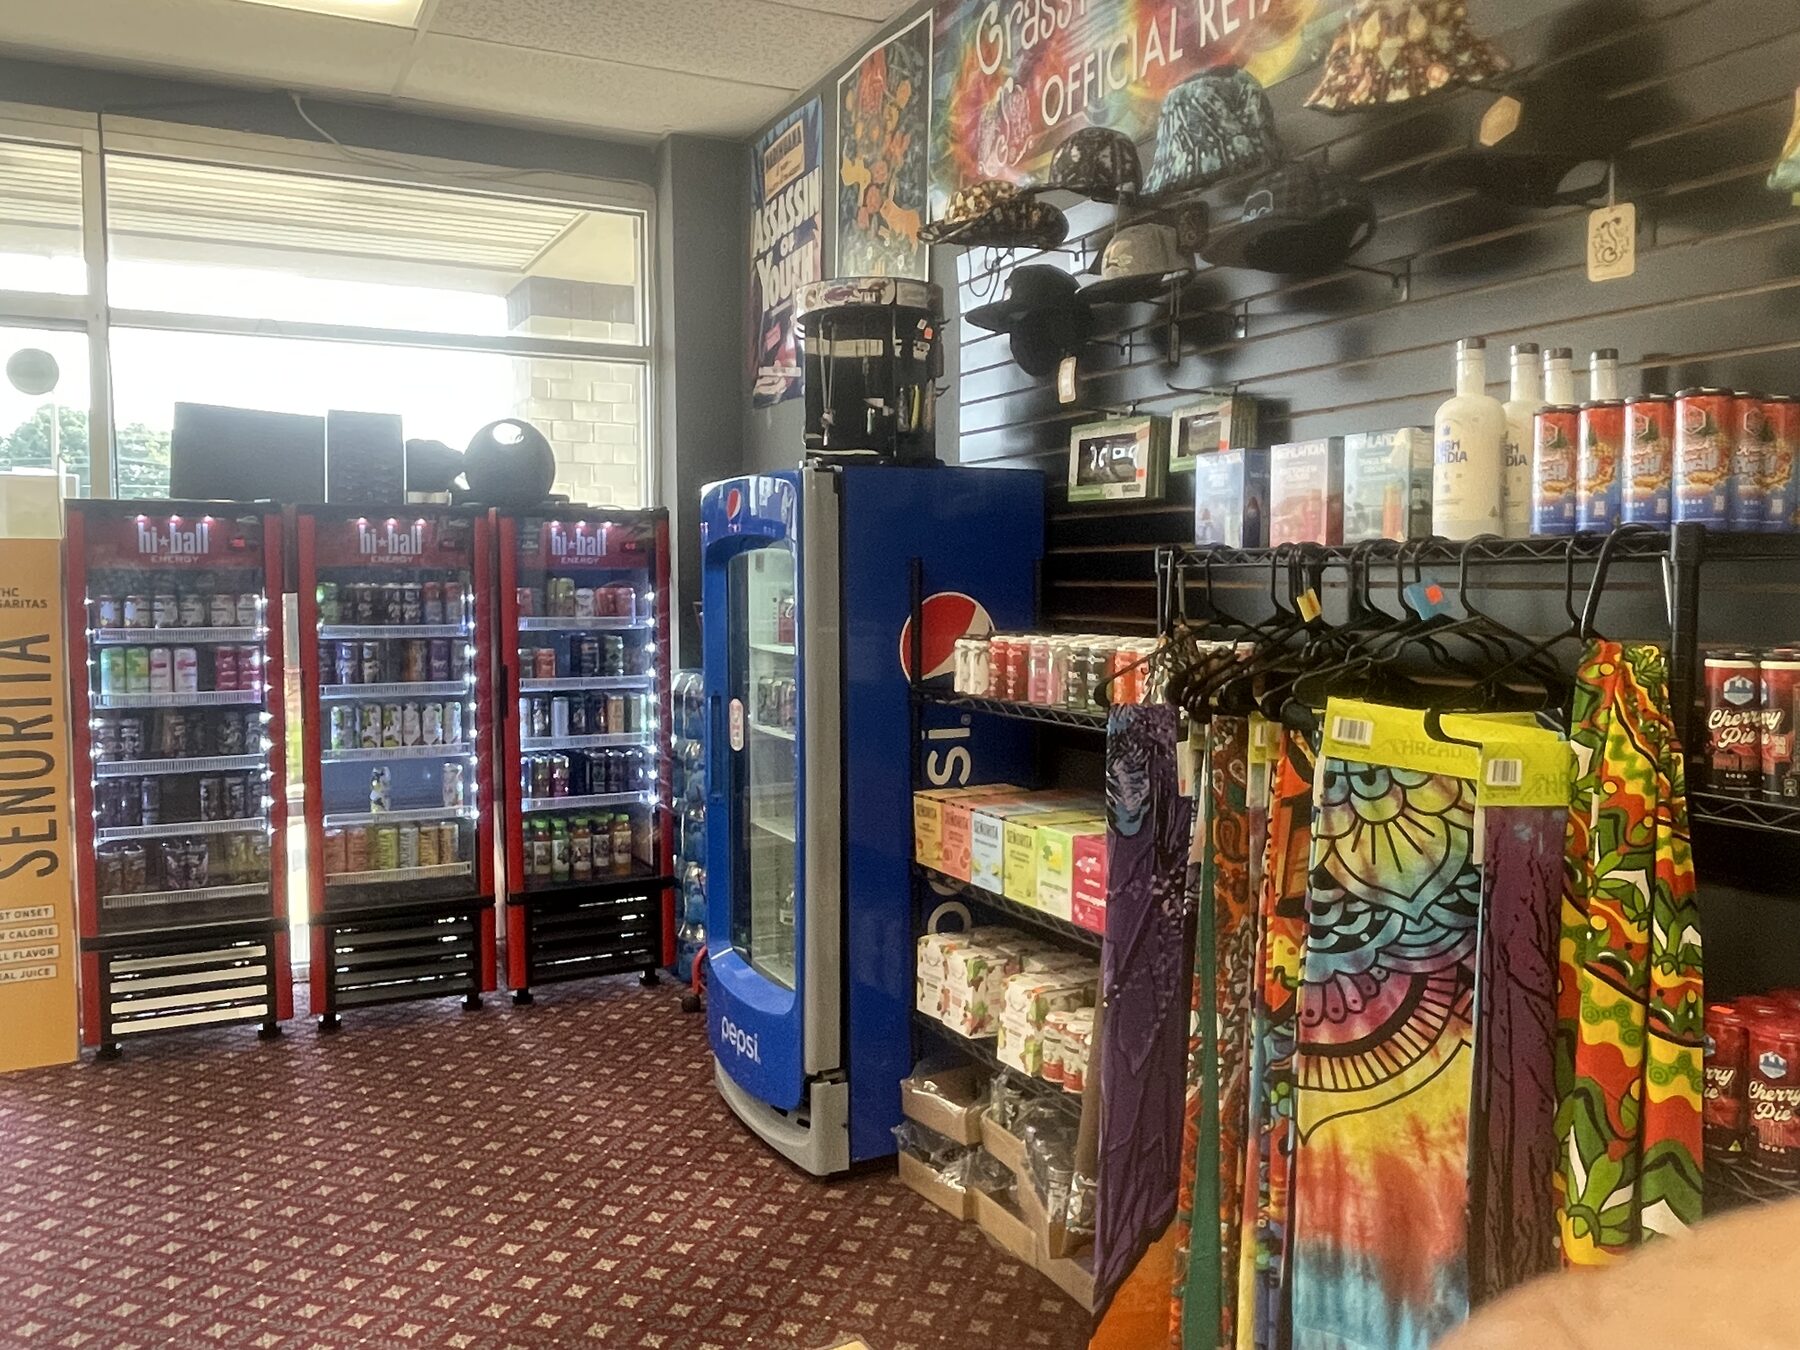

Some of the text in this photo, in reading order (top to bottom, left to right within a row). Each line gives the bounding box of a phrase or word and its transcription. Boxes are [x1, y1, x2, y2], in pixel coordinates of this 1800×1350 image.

[1041, 0, 1272, 126] OFFICIAL RE
[752, 166, 821, 260] ASSASSIN
[756, 240, 814, 313] YOUTH
[1717, 726, 1756, 748] Pie
[14, 907, 50, 919] ONSET
[9, 927, 54, 939] CALORIE
[13, 947, 54, 959] FLAVOR
[20, 967, 51, 978] JUICE
[721, 1015, 761, 1065] pepsi
[1703, 1083, 1719, 1099] ie
[1748, 1080, 1800, 1107] Cherry
[1753, 1101, 1792, 1122] Pie
